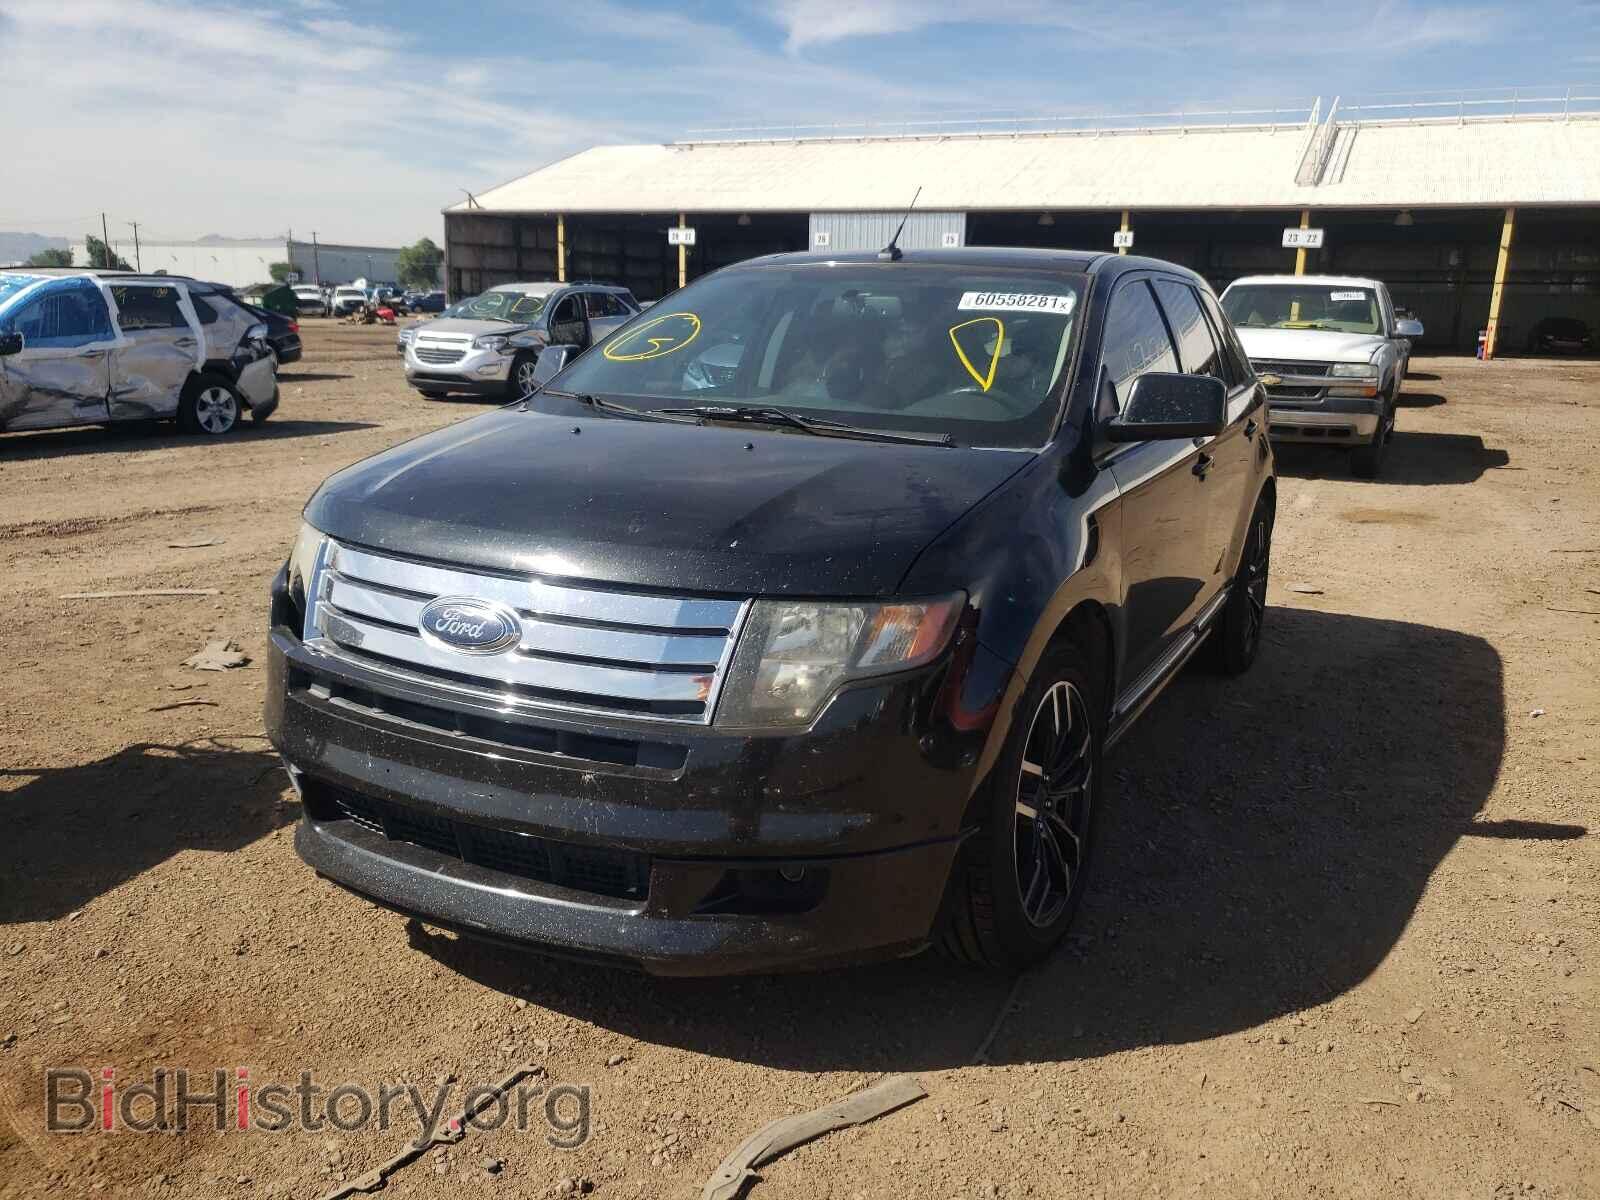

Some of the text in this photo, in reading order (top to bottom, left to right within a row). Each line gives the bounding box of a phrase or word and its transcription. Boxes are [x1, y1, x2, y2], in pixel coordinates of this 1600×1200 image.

[1118, 235, 1128, 243] 24
[1287, 233, 1317, 243] 23 22
[435, 608, 487, 638] Ford
